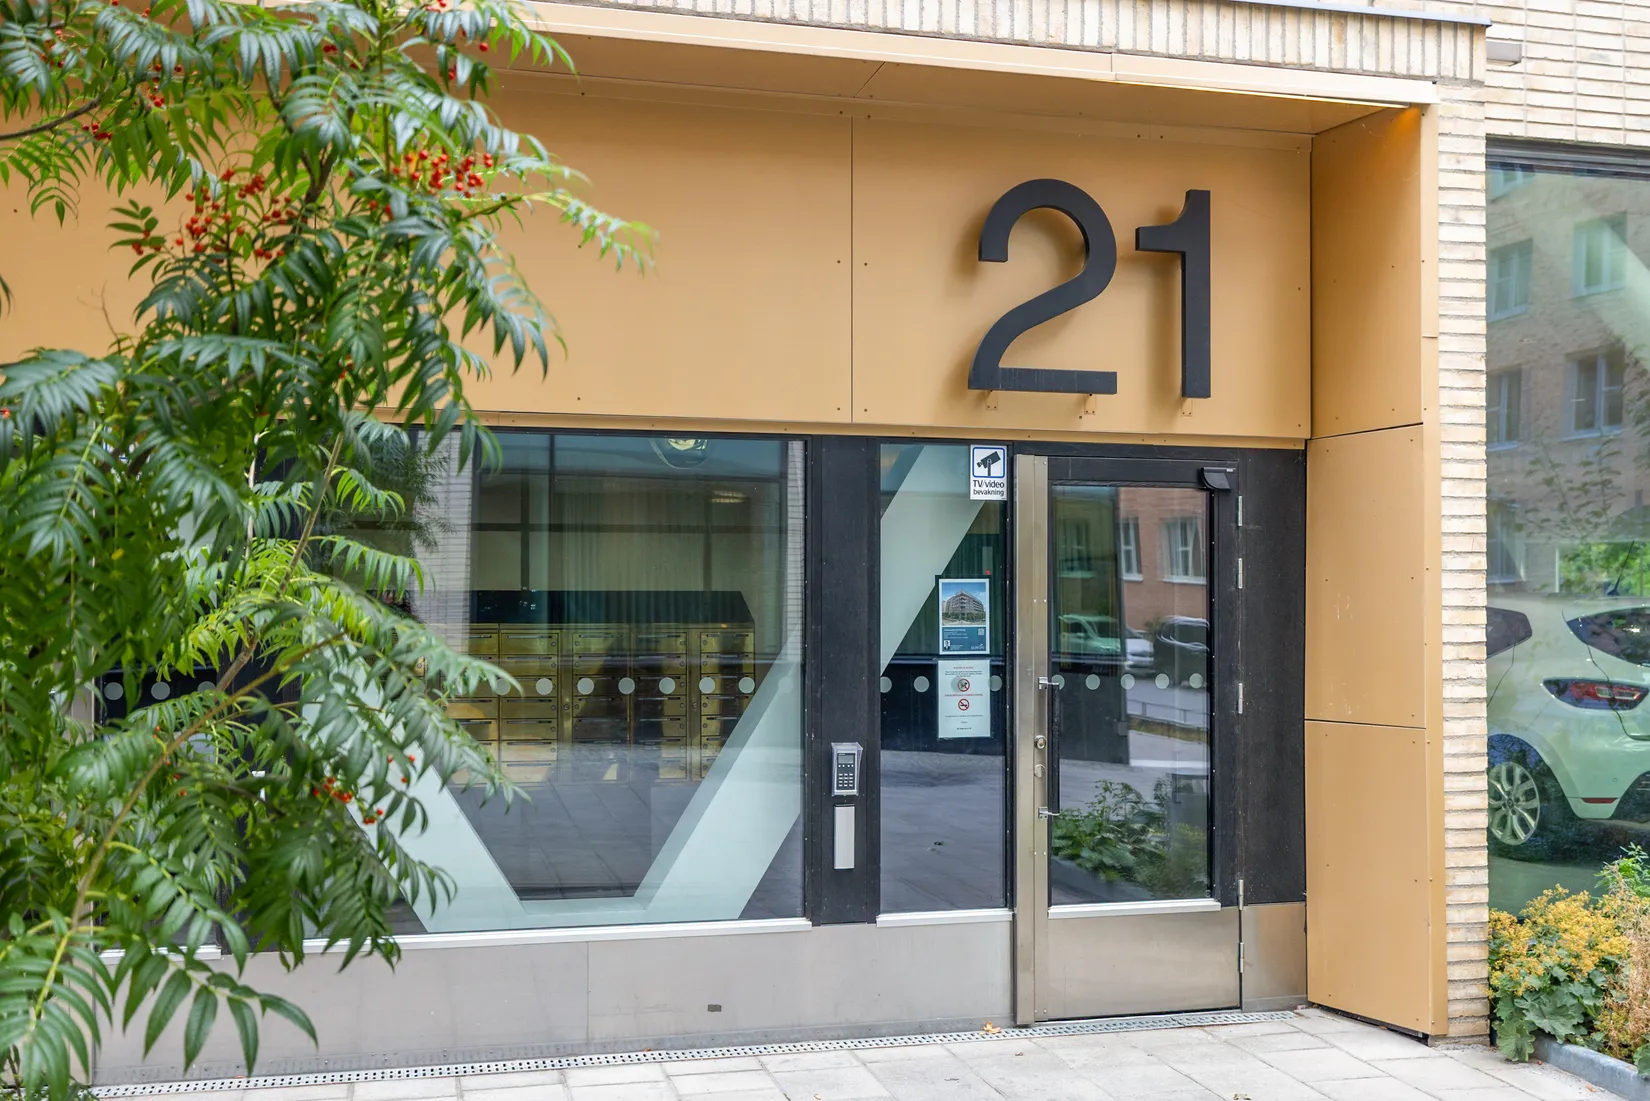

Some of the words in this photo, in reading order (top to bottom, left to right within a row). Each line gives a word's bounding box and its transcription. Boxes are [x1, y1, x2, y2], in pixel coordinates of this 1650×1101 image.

[968, 178, 1211, 398] 21
[973, 480, 1005, 488] TV/video
[973, 489, 1005, 497] bevakning
